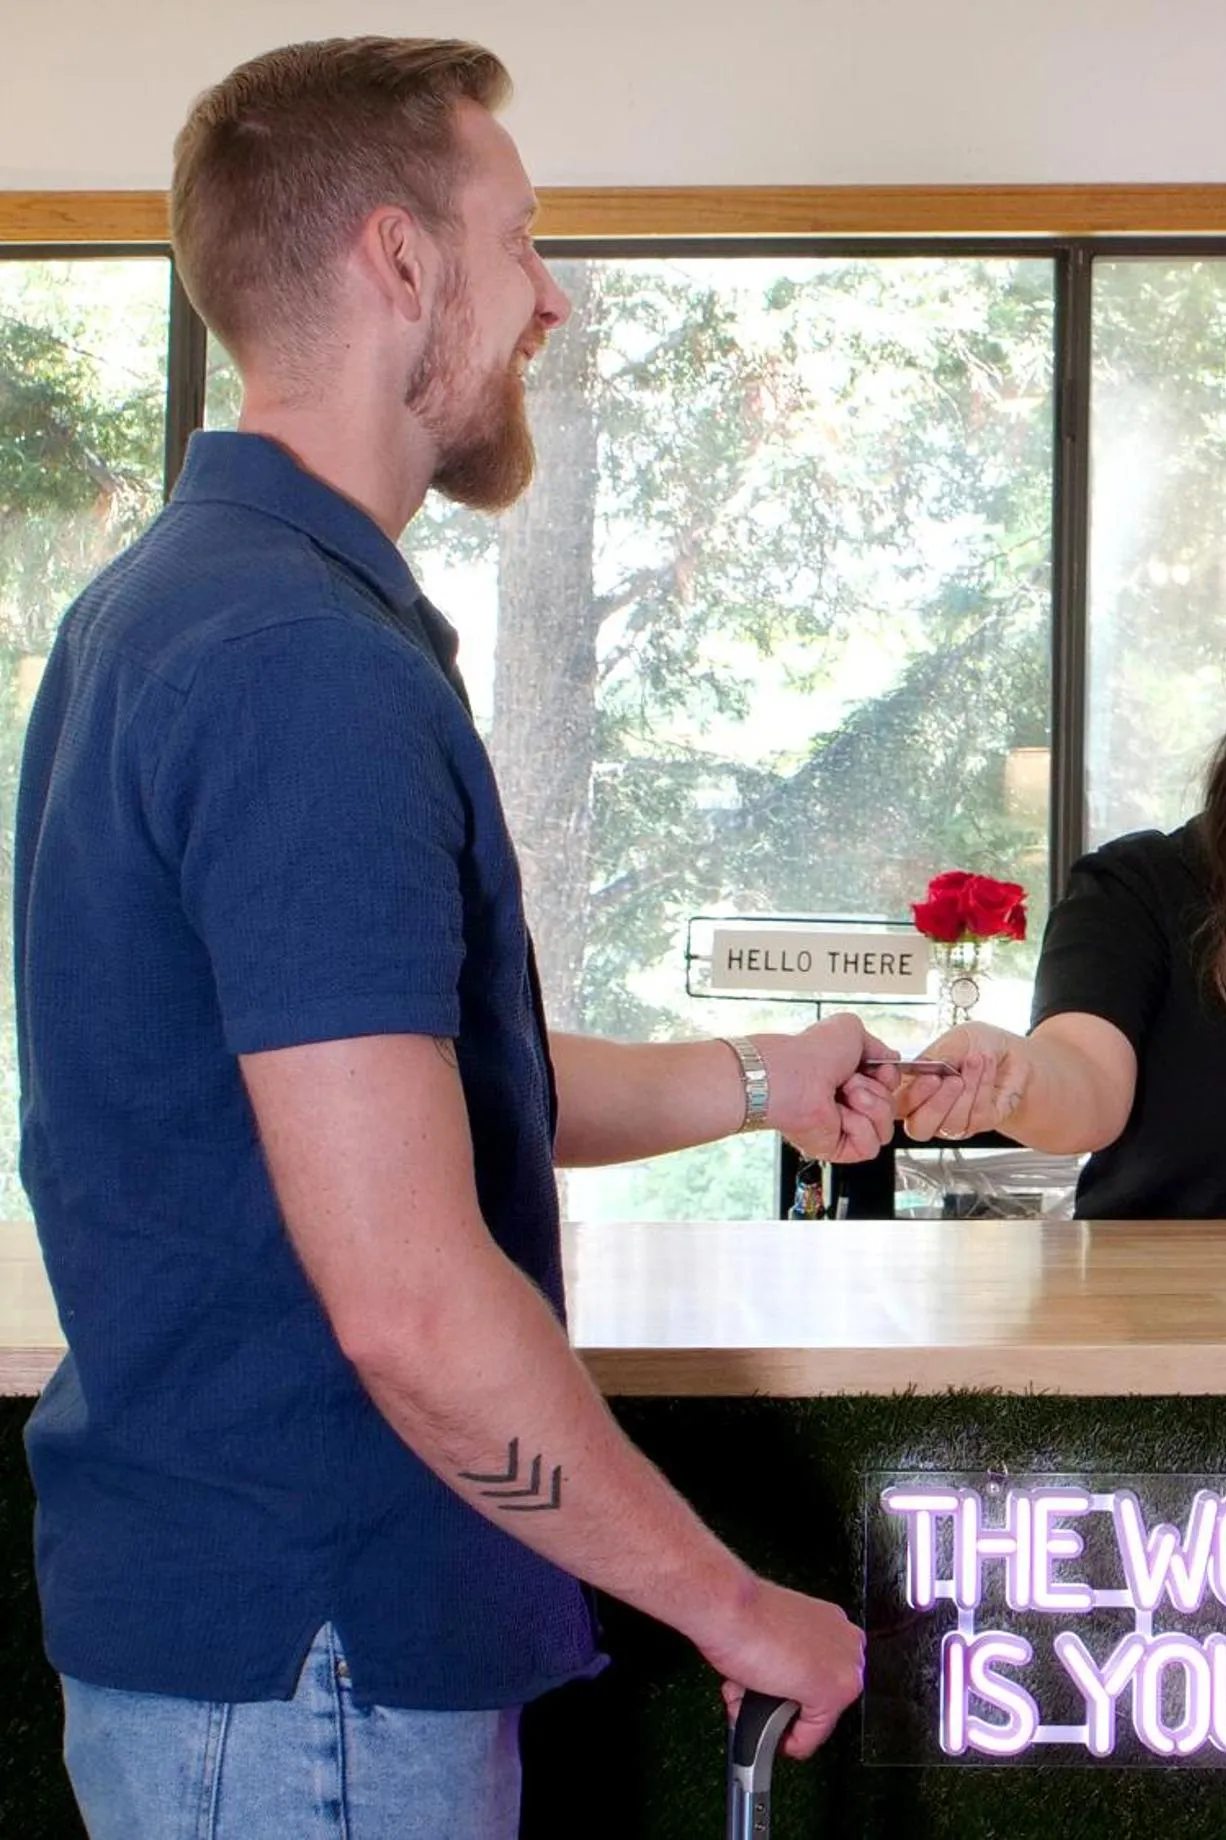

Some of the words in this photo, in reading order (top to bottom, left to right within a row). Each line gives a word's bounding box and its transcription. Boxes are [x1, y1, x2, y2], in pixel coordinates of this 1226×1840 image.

[727, 948, 813, 973] HELLO
[827, 951, 914, 976] THERE
[881, 1487, 1094, 1612] THE
[940, 1631, 1038, 1756] IS
